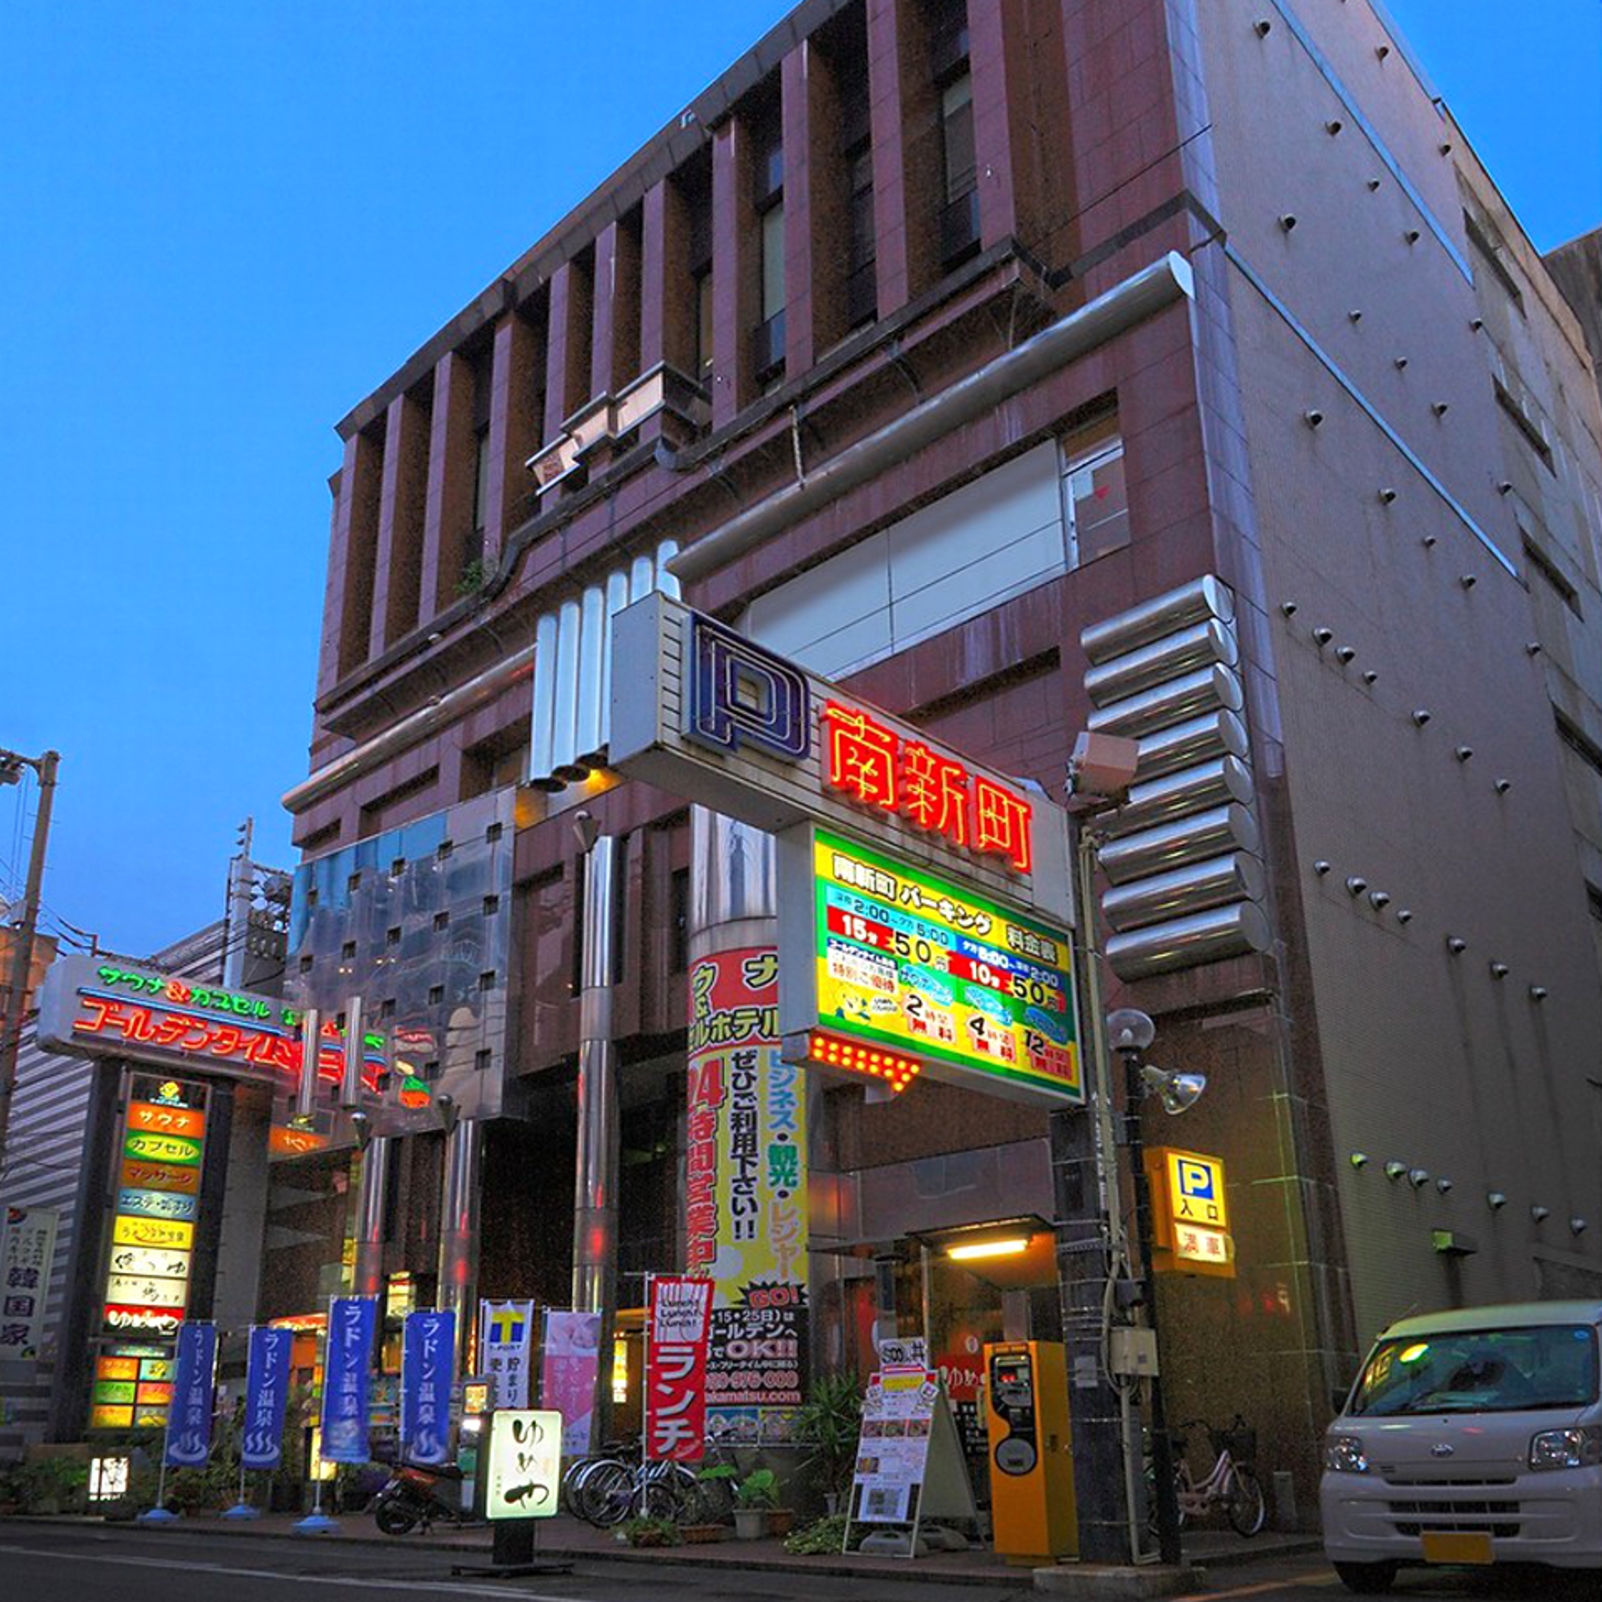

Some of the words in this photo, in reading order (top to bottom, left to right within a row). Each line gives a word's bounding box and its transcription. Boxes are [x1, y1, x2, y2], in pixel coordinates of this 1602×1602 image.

[682, 611, 811, 760] P
[822, 698, 1032, 873] 南新町
[832, 853, 897, 901] 南新町
[899, 884, 993, 937] パーキング
[1005, 924, 1058, 966] 料金表
[841, 914, 879, 947] 15分
[894, 931, 949, 972] 50円
[969, 960, 1001, 989] 10分
[1013, 974, 1058, 1013] 50円
[132, 1139, 195, 1156] カプセル
[139, 1110, 190, 1128] サウナ
[1181, 1162, 1210, 1194] P
[1181, 1198, 1219, 1220] 入口
[1, 1267, 39, 1345] 韓国家
[748, 1285, 800, 1309] GO!
[186, 1330, 203, 1426] ラドン温泉
[254, 1333, 280, 1427] ラドン温泉
[341, 1304, 364, 1416] ラドン温泉
[416, 1317, 440, 1424] ラドン温泉
[507, 1357, 520, 1408] 貯まり
[653, 1346, 696, 1454] ランチ
[504, 1418, 550, 1509] ゆめや
